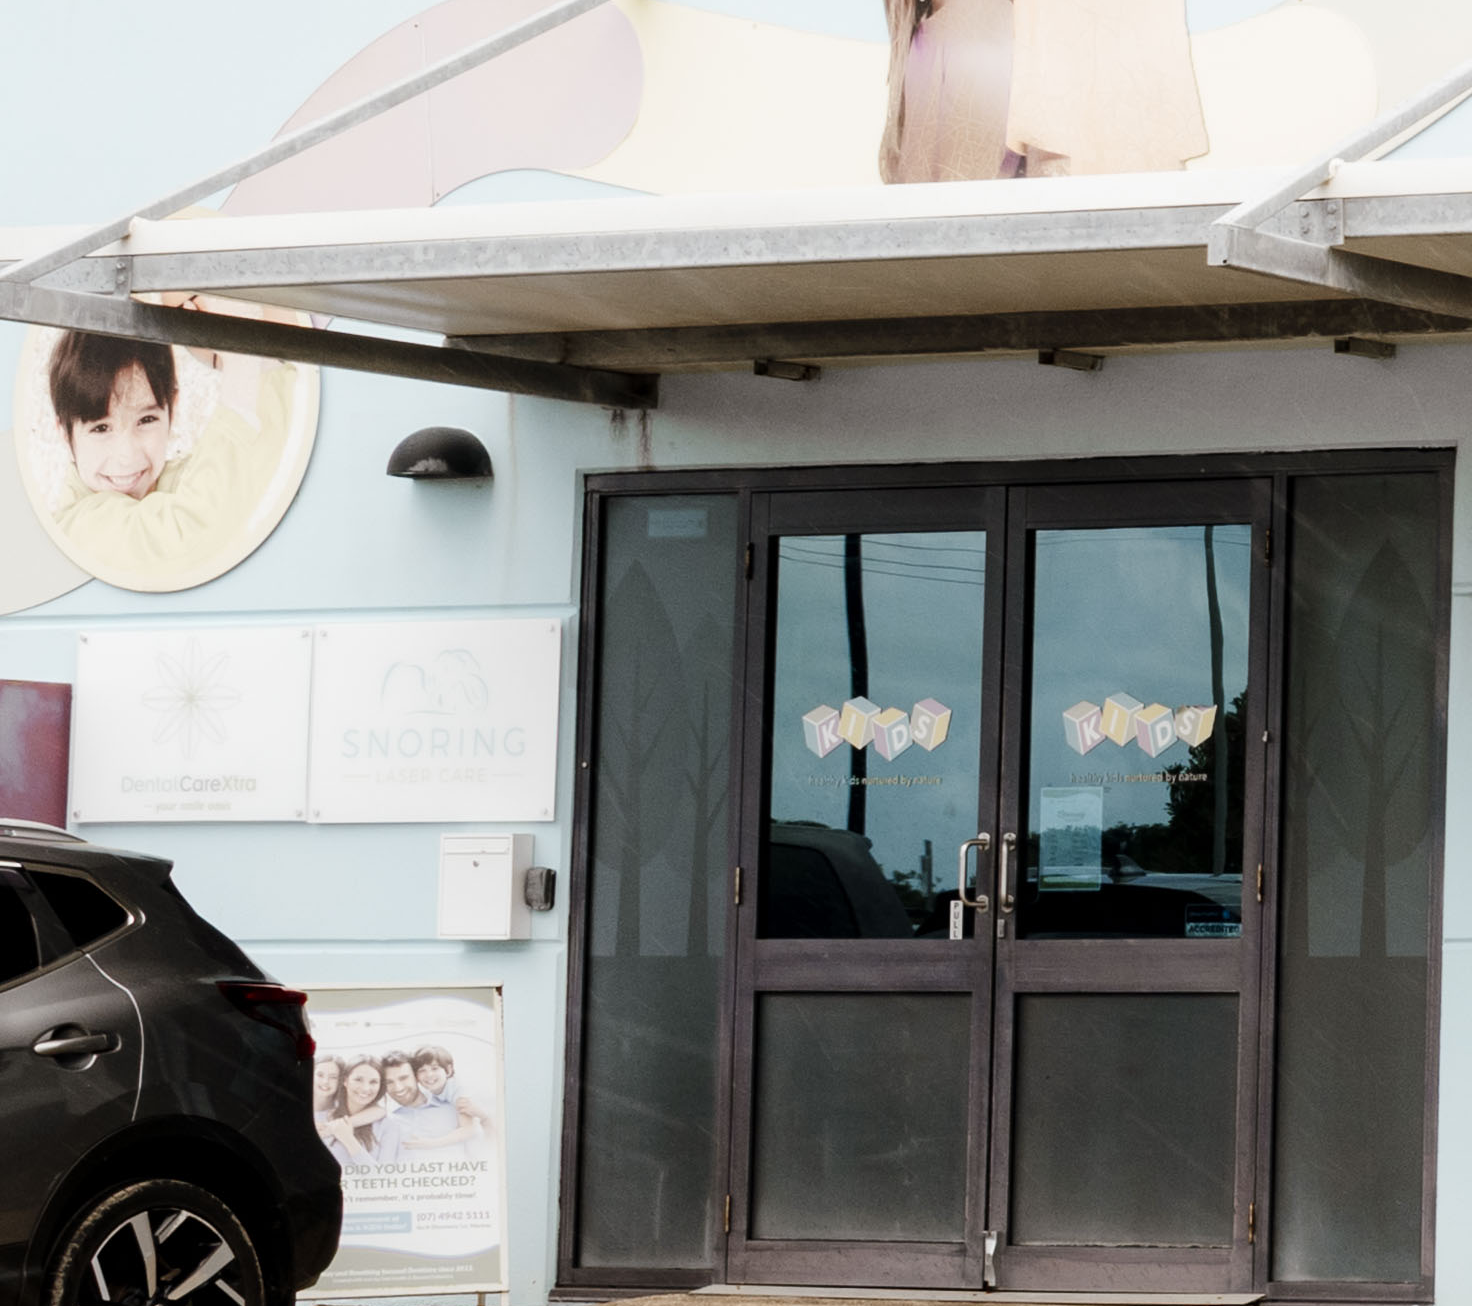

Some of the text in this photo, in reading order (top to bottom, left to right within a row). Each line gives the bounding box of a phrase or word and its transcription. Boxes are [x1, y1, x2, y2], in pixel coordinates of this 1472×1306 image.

[342, 727, 526, 759] SNORING
[376, 768, 488, 783] LASER CARE
[900, 776, 911, 787] by
[913, 776, 940, 785] nature
[1124, 772, 1163, 782] nurtured
[1166, 772, 1176, 784] by
[1179, 772, 1207, 781] nature
[121, 776, 256, 793] DentalCareXtra
[345, 1161, 488, 1175] DID YOU LAST HAVE
[353, 1178, 397, 1189] TEETH
[402, 1176, 476, 1188] CHECKED?
[417, 1193, 453, 1201] probably
[416, 1212, 436, 1222] (07)
